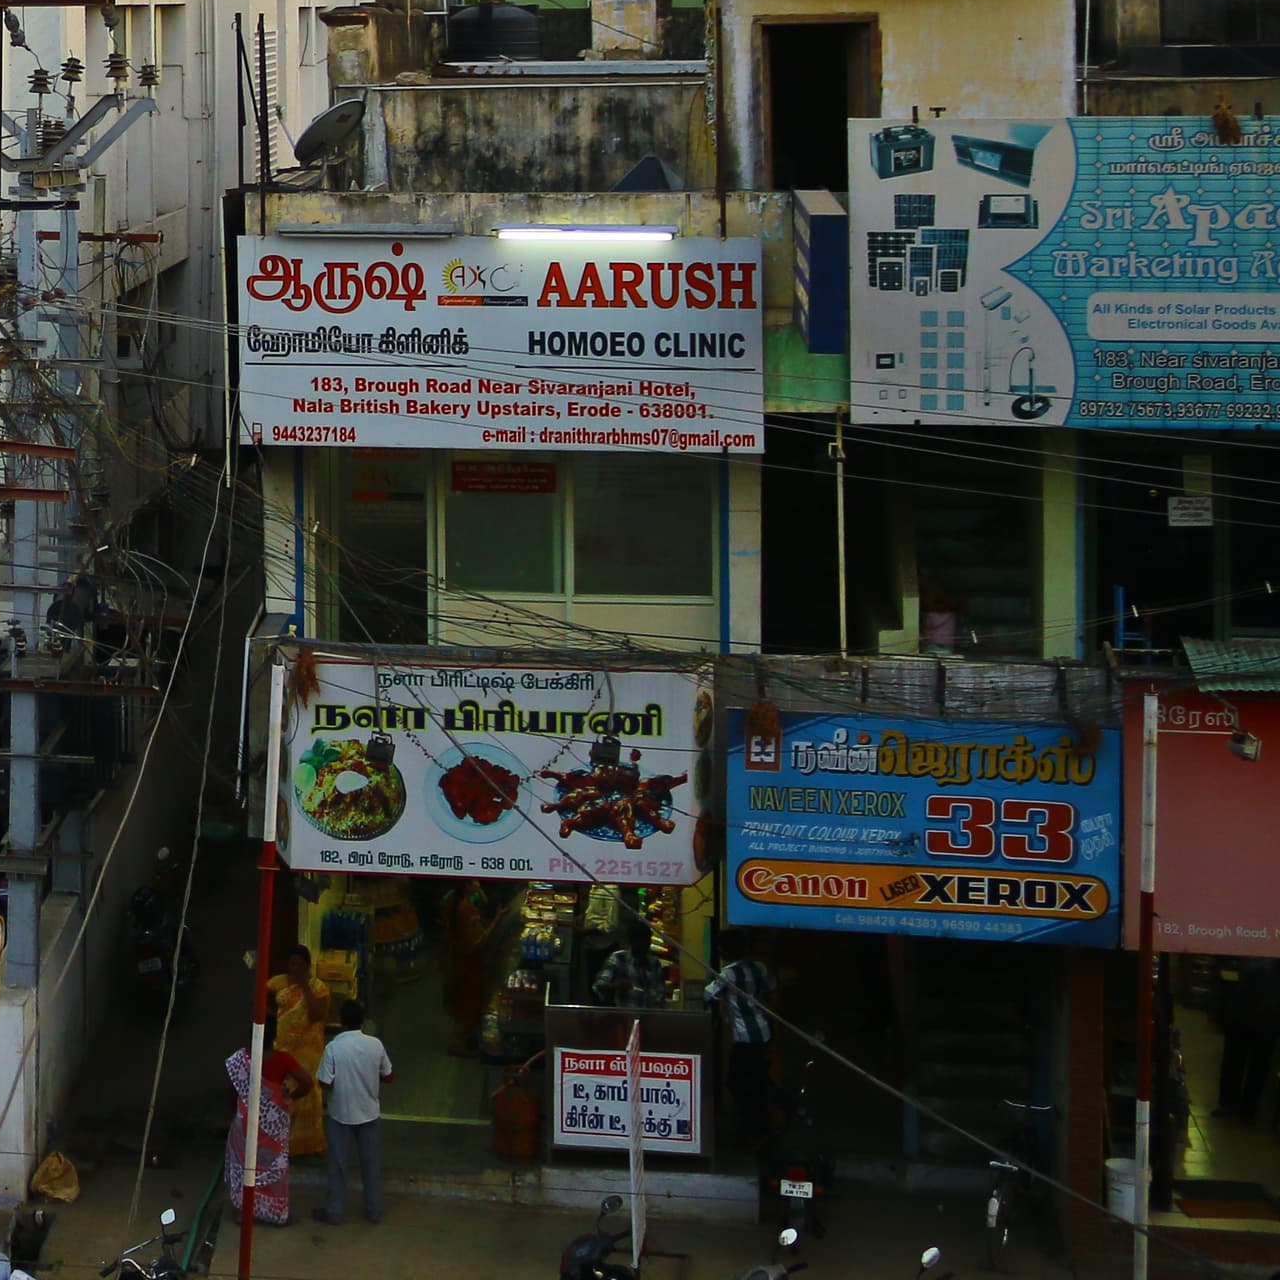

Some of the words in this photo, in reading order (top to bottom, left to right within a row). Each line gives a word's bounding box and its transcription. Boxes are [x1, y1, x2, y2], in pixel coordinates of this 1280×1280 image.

[1080, 200, 1134, 229] Sri
[1140, 185, 1280, 246] Apa
[246, 242, 427, 313] ஆருஷ்
[1051, 250, 1239, 285] Marketing
[537, 261, 757, 309] AARUSH
[1093, 304, 1111, 314] All
[1115, 304, 1153, 314] Kinds
[1158, 303, 1171, 314] of
[1175, 304, 1210, 315] Solar
[1215, 304, 1276, 315] Products
[1128, 318, 1207, 329] Electronical
[1212, 319, 1256, 330] Goods
[528, 331, 645, 358] HOMOEO
[654, 331, 746, 359] CLINIC
[1094, 350, 1134, 370] 183,
[1141, 351, 1187, 369] Near
[311, 377, 348, 395] 183,
[355, 378, 419, 396] Brough
[426, 379, 471, 393] Road
[478, 379, 521, 394] Near
[528, 380, 633, 398] Sivaranjani
[1112, 373, 1180, 393] Brough
[1186, 374, 1244, 392] Road,
[293, 398, 334, 414] Nala
[340, 399, 400, 414] British
[406, 400, 470, 418] Bakery
[477, 401, 560, 419] Upstairs,
[568, 402, 621, 417] Erode
[272, 426, 357, 443] 9443237184
[483, 427, 526, 443] e-mail
[377, 672, 425, 691] நளா
[311, 702, 430, 734] நளா
[443, 699, 662, 737] பிரியாணி
[749, 785, 833, 814] NAVEEN
[836, 790, 907, 818] XEROX
[808, 825, 858, 842] COLOUR
[926, 795, 1075, 863] 33
[320, 851, 342, 864] 182,
[481, 856, 505, 870] 638
[595, 857, 685, 878] 2251527
[741, 866, 869, 901] Canon
[880, 874, 921, 902] LASER
[916, 872, 1100, 913] XEROX
[1188, 924, 1232, 939] Brough
[565, 1057, 606, 1071] நளா
